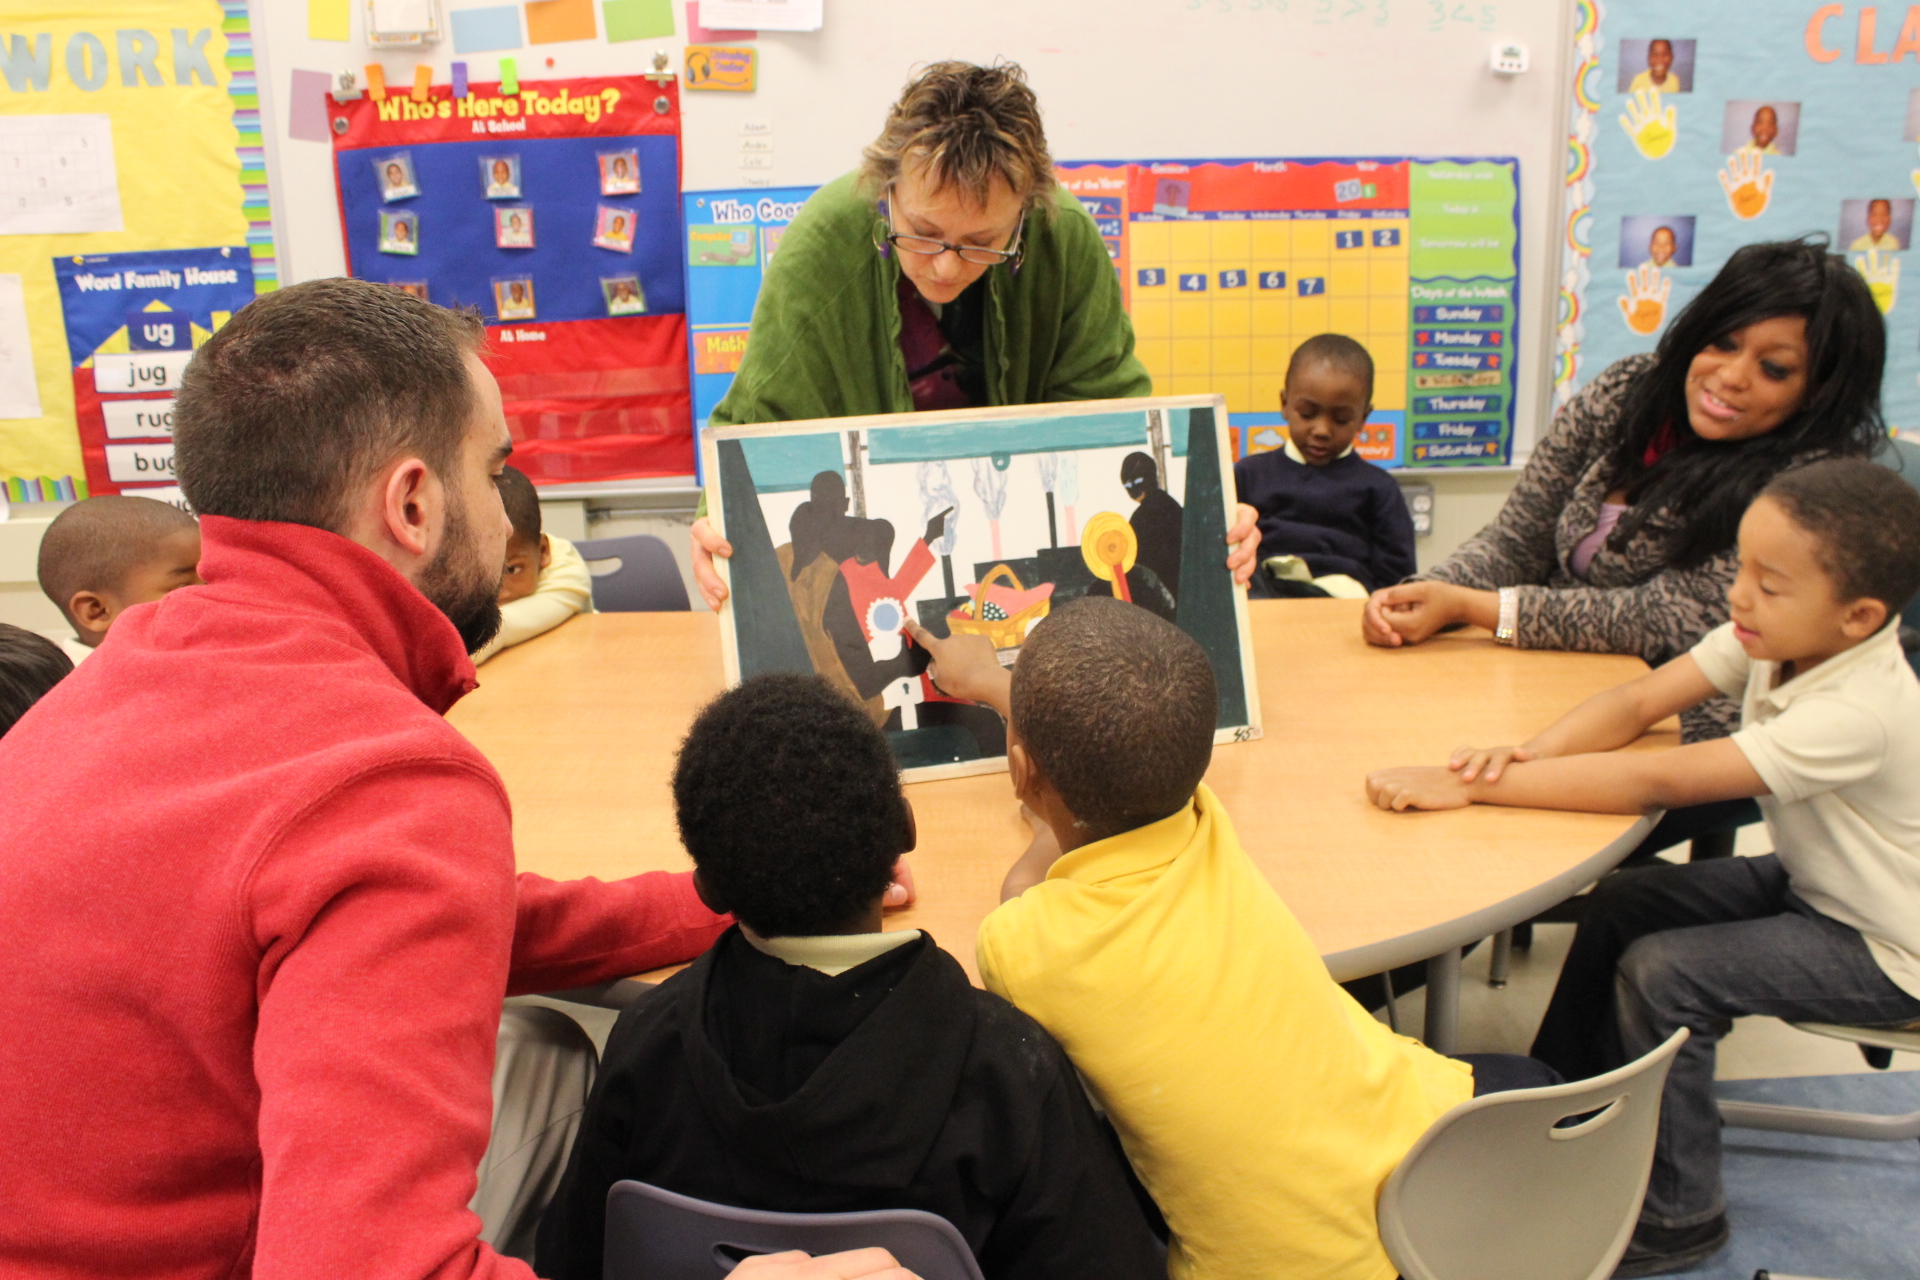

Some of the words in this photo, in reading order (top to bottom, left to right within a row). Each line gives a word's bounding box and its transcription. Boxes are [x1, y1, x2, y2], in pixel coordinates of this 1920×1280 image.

[1804, 3, 1920, 65] CLA
[0, 28, 218, 93] WORK
[376, 95, 452, 122] Who's
[457, 91, 520, 118] Here
[519, 87, 621, 124] Today?
[472, 120, 486, 134] At
[487, 117, 526, 133] School
[1151, 163, 1190, 175] Season
[1253, 160, 1289, 174] Month
[1356, 160, 1380, 172] Year
[1098, 176, 1127, 190] Year
[712, 201, 753, 222] Who
[1345, 231, 1354, 249] 1
[1379, 229, 1393, 247] 2
[74, 273, 122, 293] Word
[124, 270, 182, 290] Family
[183, 266, 238, 286] House
[1145, 269, 1157, 286] 3
[1186, 275, 1200, 291] 4
[1225, 271, 1239, 287] 5
[1266, 272, 1280, 289] 6
[1303, 278, 1317, 295] 7
[1410, 285, 1444, 301] Days
[1435, 306, 1483, 322] Sunday
[143, 323, 175, 348] ug
[500, 329, 514, 343] At
[515, 329, 547, 342] Home
[1434, 331, 1483, 347] Monday
[1432, 352, 1483, 369] Tuesday
[127, 362, 167, 387] jug
[1429, 396, 1487, 412] Thursday
[1438, 422, 1477, 438] Friday
[1428, 442, 1485, 458] Saturday
